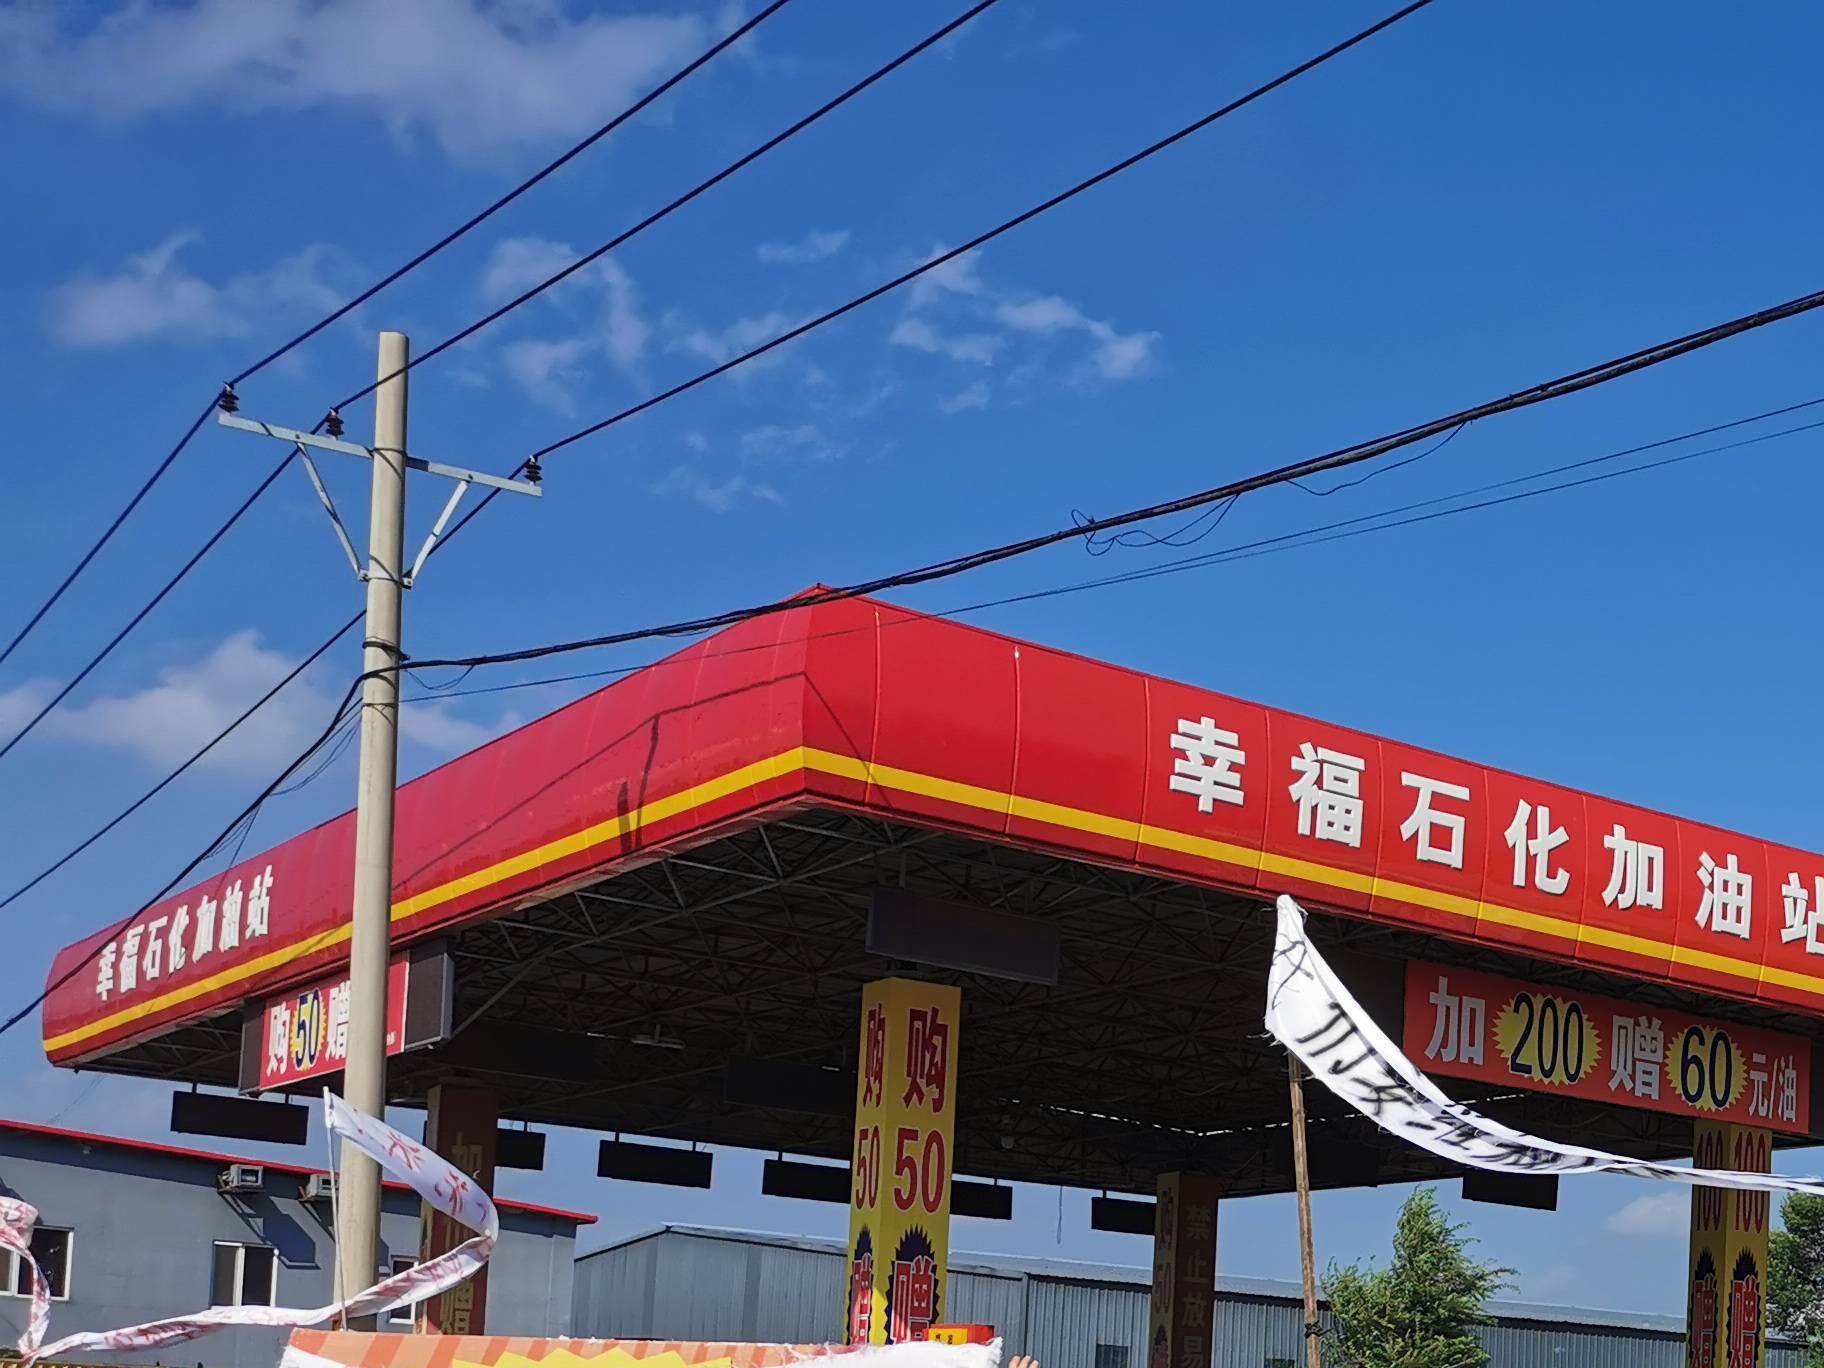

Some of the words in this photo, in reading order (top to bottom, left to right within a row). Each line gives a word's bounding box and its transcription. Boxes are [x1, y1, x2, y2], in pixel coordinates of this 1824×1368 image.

[95, 865, 274, 1000] 幸福石化加油站
